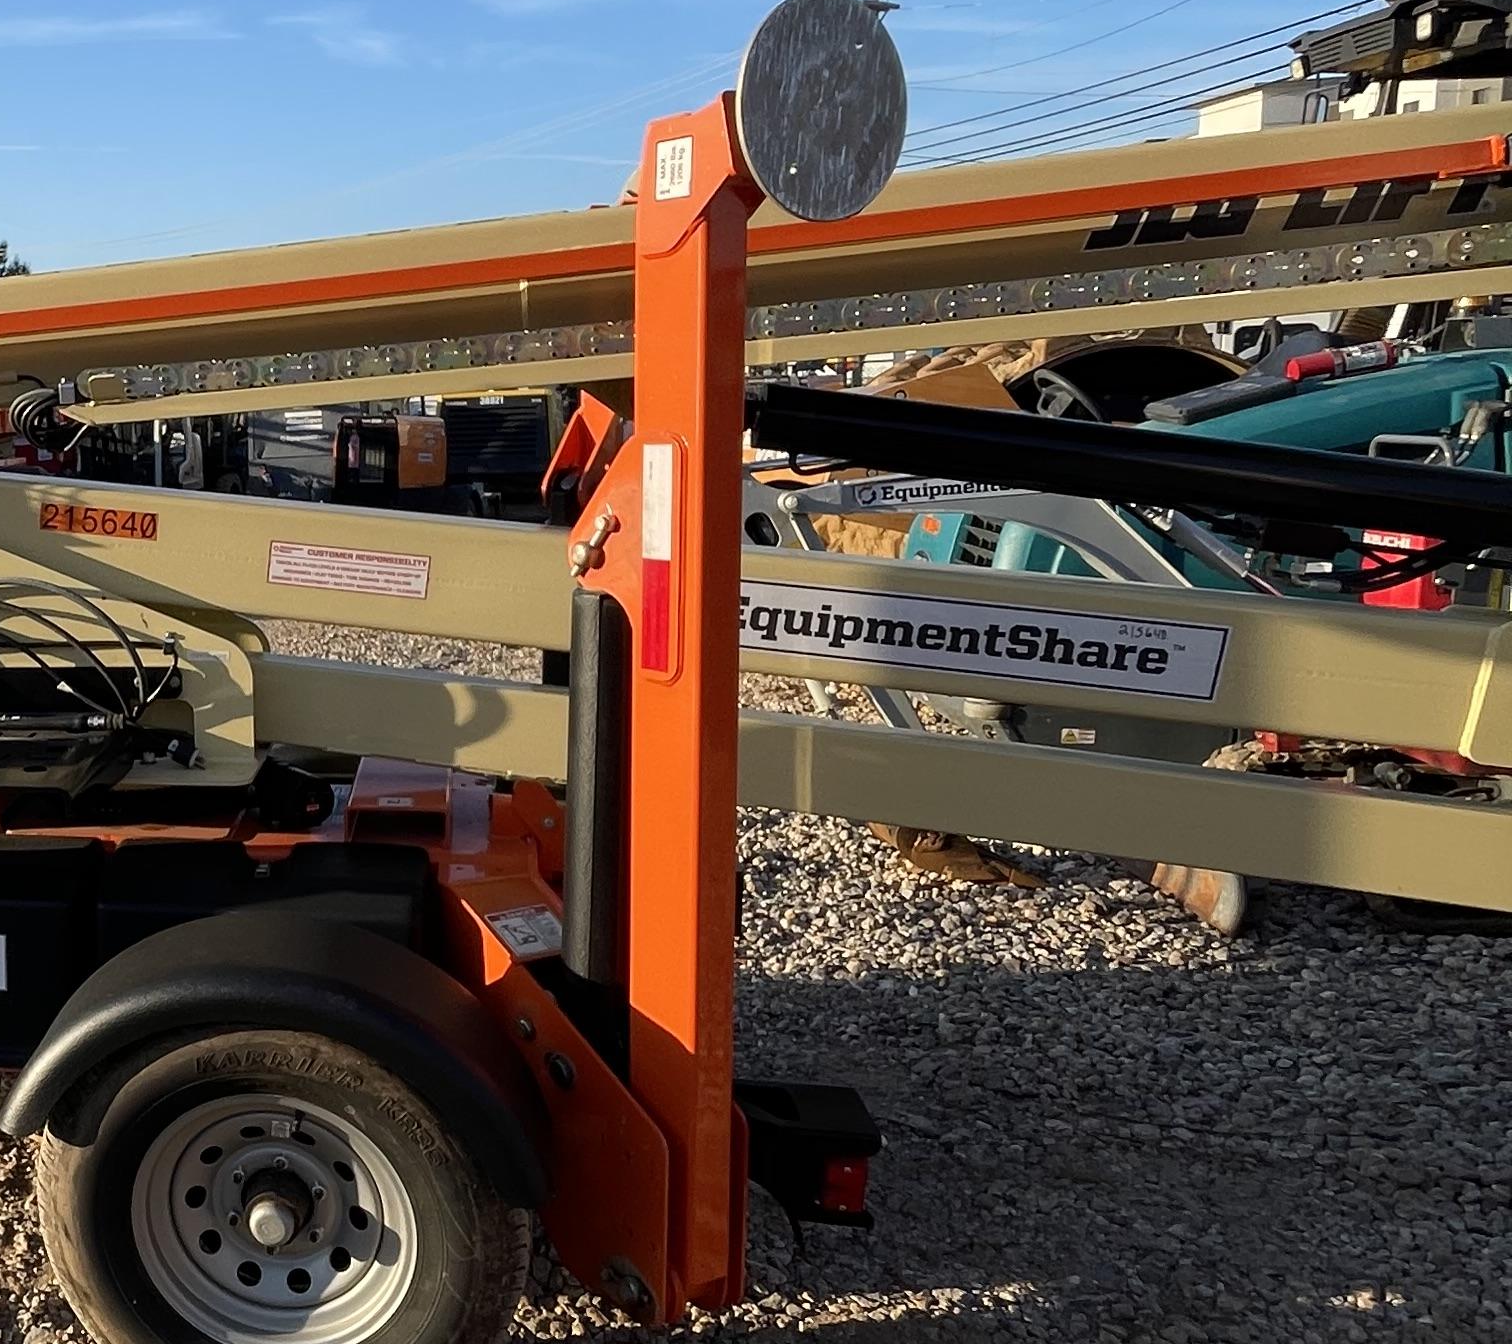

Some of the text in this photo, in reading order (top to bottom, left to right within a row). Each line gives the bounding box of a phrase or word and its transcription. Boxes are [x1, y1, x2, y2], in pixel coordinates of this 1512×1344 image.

[42, 503, 157, 538] 215640
[306, 548, 353, 559] CUSTOMER
[195, 1050, 364, 1091] KARRIER
